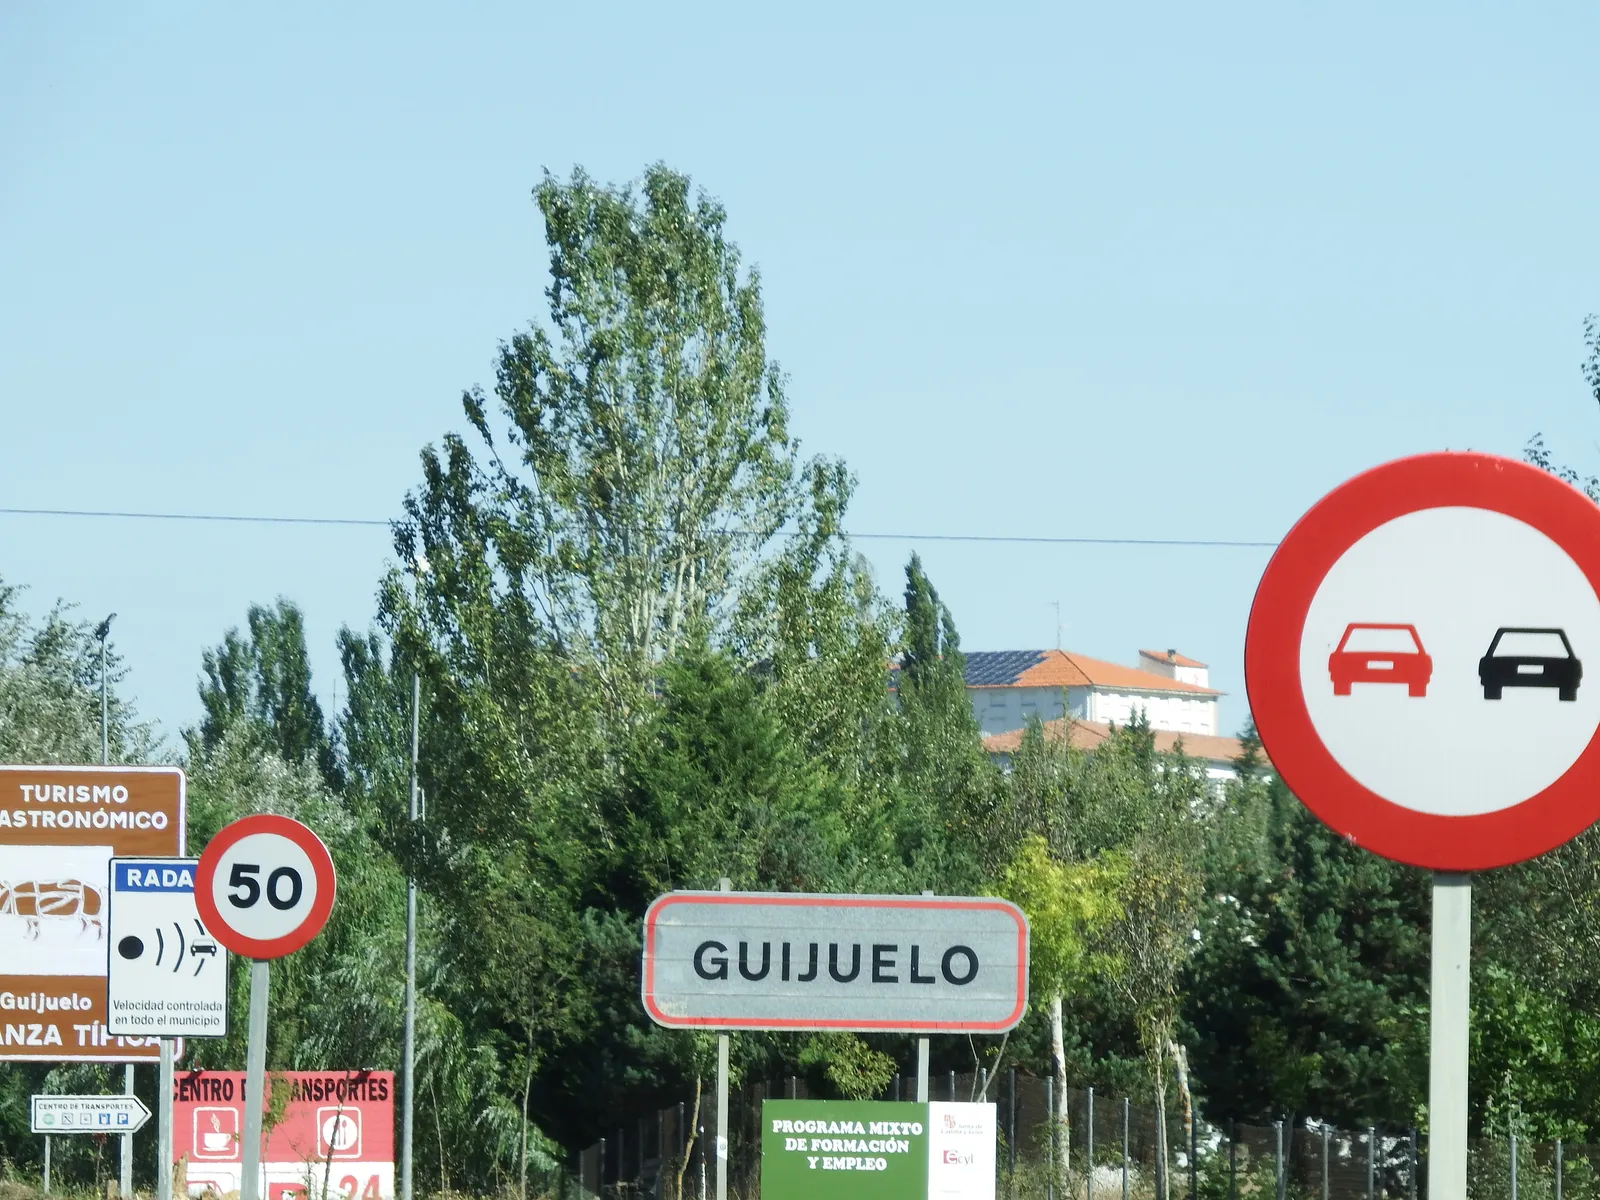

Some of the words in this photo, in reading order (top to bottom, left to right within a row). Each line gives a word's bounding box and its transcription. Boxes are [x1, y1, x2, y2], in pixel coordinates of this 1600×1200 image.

[20, 784, 129, 803] TURISMO
[0, 808, 168, 830] ASTRONÓMICO
[127, 869, 194, 887] RADA
[227, 863, 303, 910] 50
[693, 940, 979, 985] GUIJUELO
[0, 991, 92, 1014] Guijuelo
[113, 1000, 164, 1011] Velocidad
[166, 1001, 222, 1011] controlada
[115, 1017, 128, 1025] en
[131, 1015, 154, 1025] todo
[157, 1015, 167, 1025] el
[169, 1015, 220, 1028] municipio
[0, 1023, 62, 1046] NZA
[290, 1078, 388, 1102] ANSPORTES
[772, 1120, 866, 1135] PROGRAMA
[869, 1121, 923, 1136] MIXTO
[785, 1138, 807, 1152] DE
[811, 1137, 909, 1153] FORMACIÓN
[807, 1156, 819, 1170] Y
[822, 1157, 887, 1171] EMPLEO
